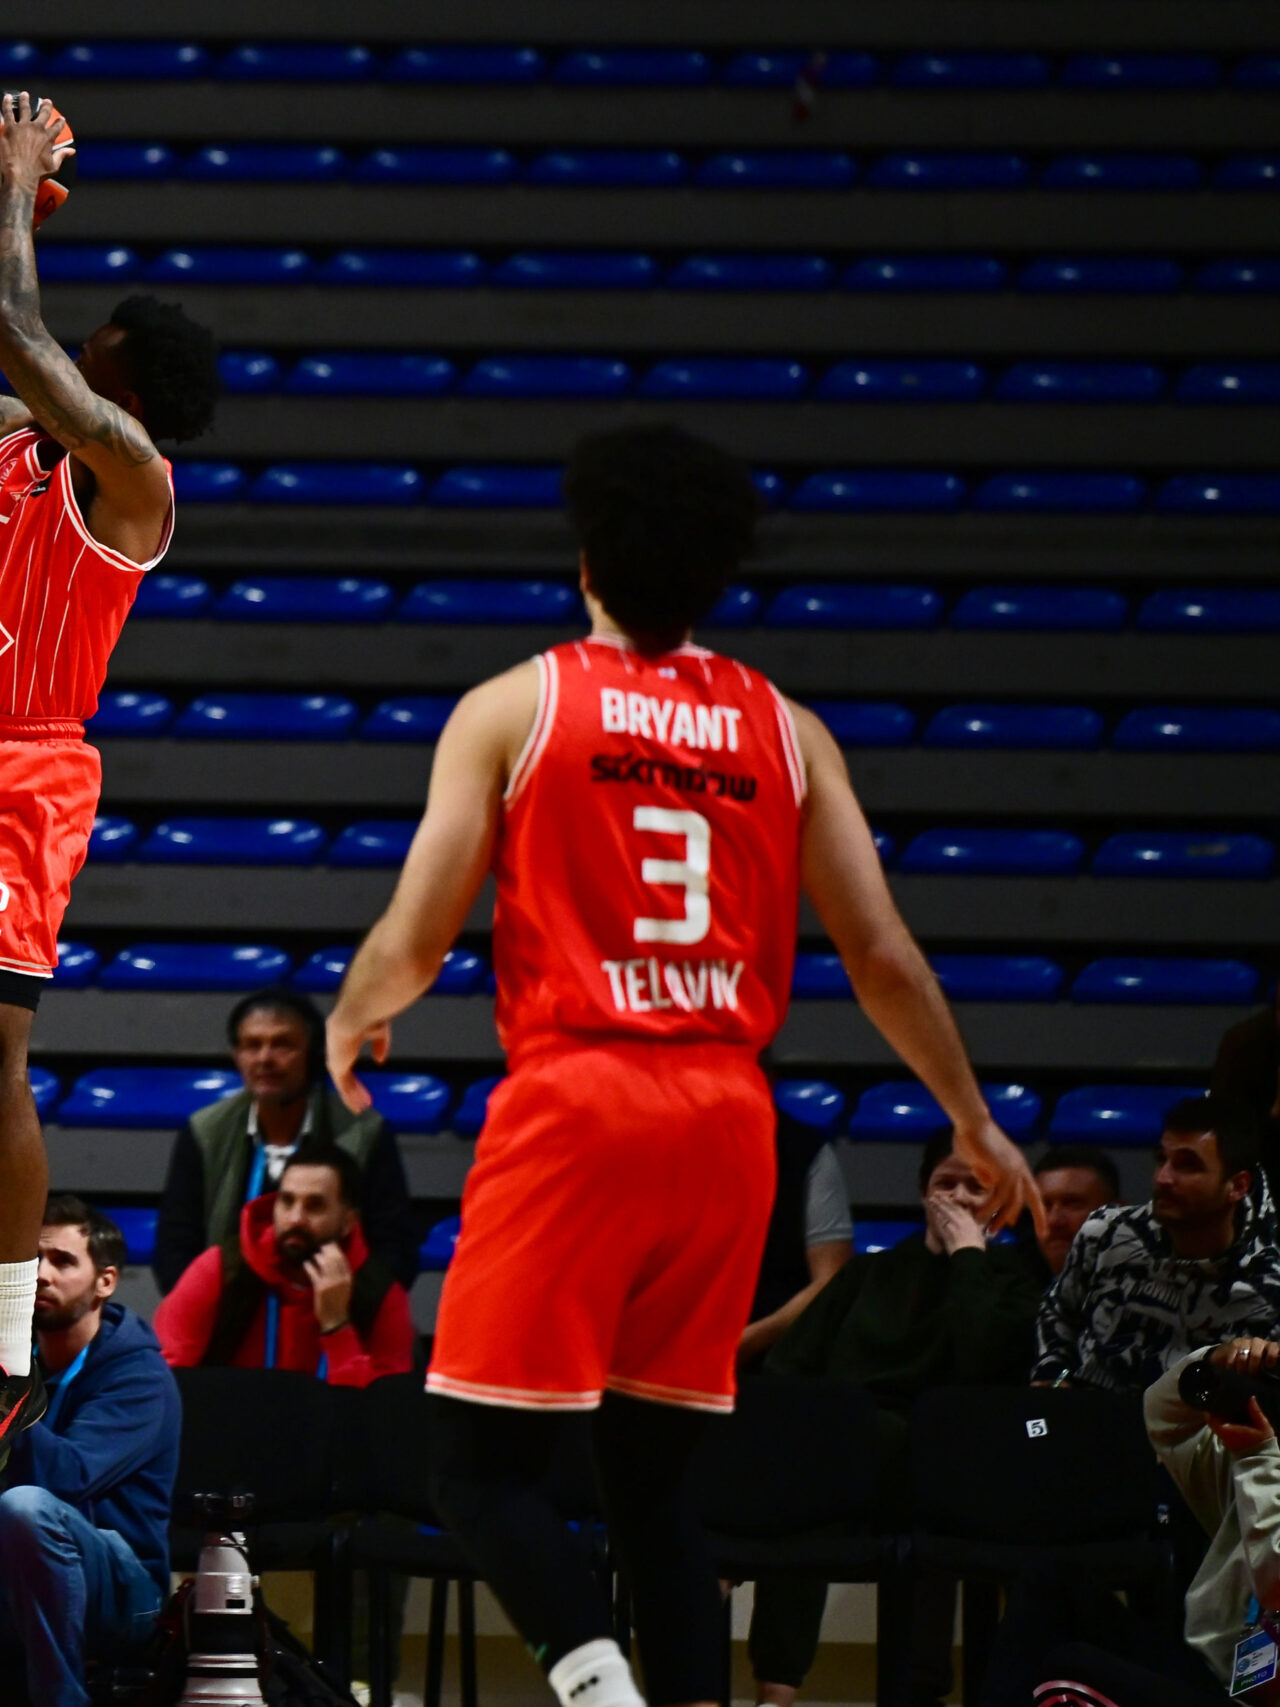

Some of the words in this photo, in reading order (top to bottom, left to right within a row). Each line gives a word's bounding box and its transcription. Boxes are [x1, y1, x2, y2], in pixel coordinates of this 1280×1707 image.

[600, 687, 742, 752] BRYANT
[633, 806, 711, 945] 3
[1030, 1421, 1044, 1436] 5
